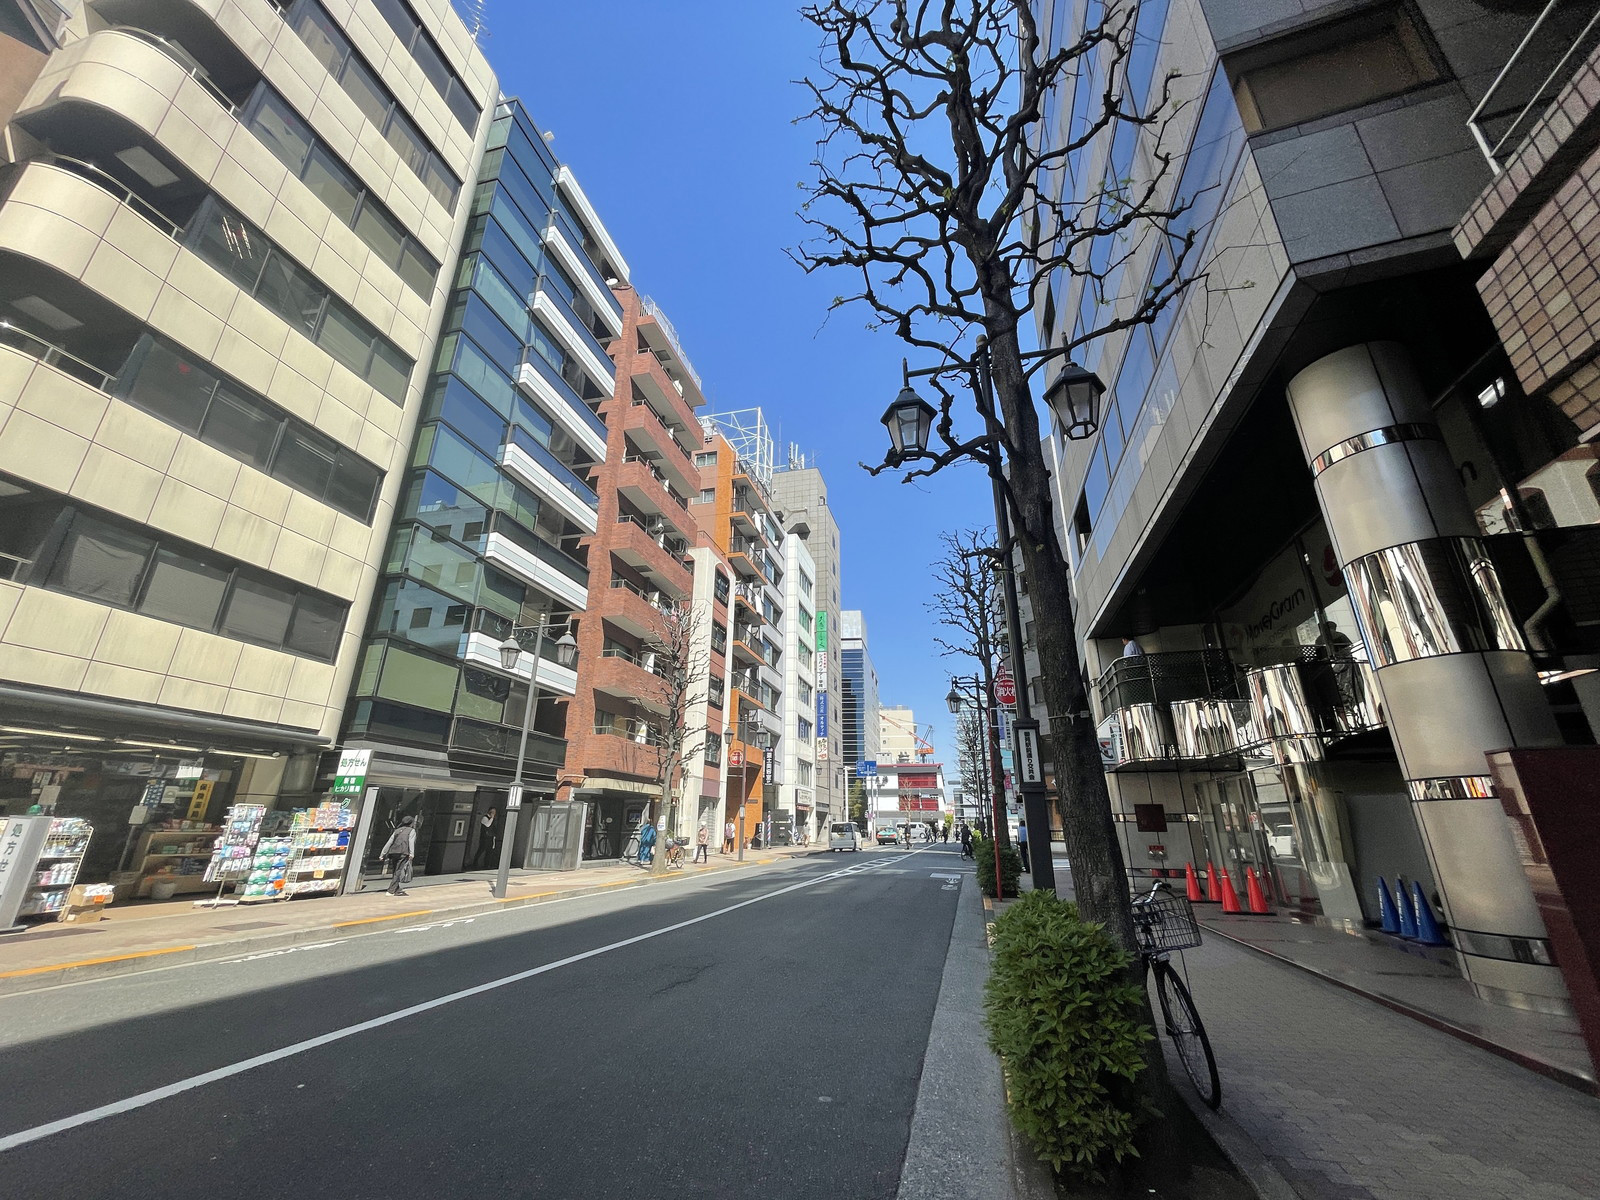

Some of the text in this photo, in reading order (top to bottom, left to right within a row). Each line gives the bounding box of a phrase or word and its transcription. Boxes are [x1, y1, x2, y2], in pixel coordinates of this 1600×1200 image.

[1246, 588, 1306, 640] MoneyGram
[340, 758, 367, 767] 処方せん
